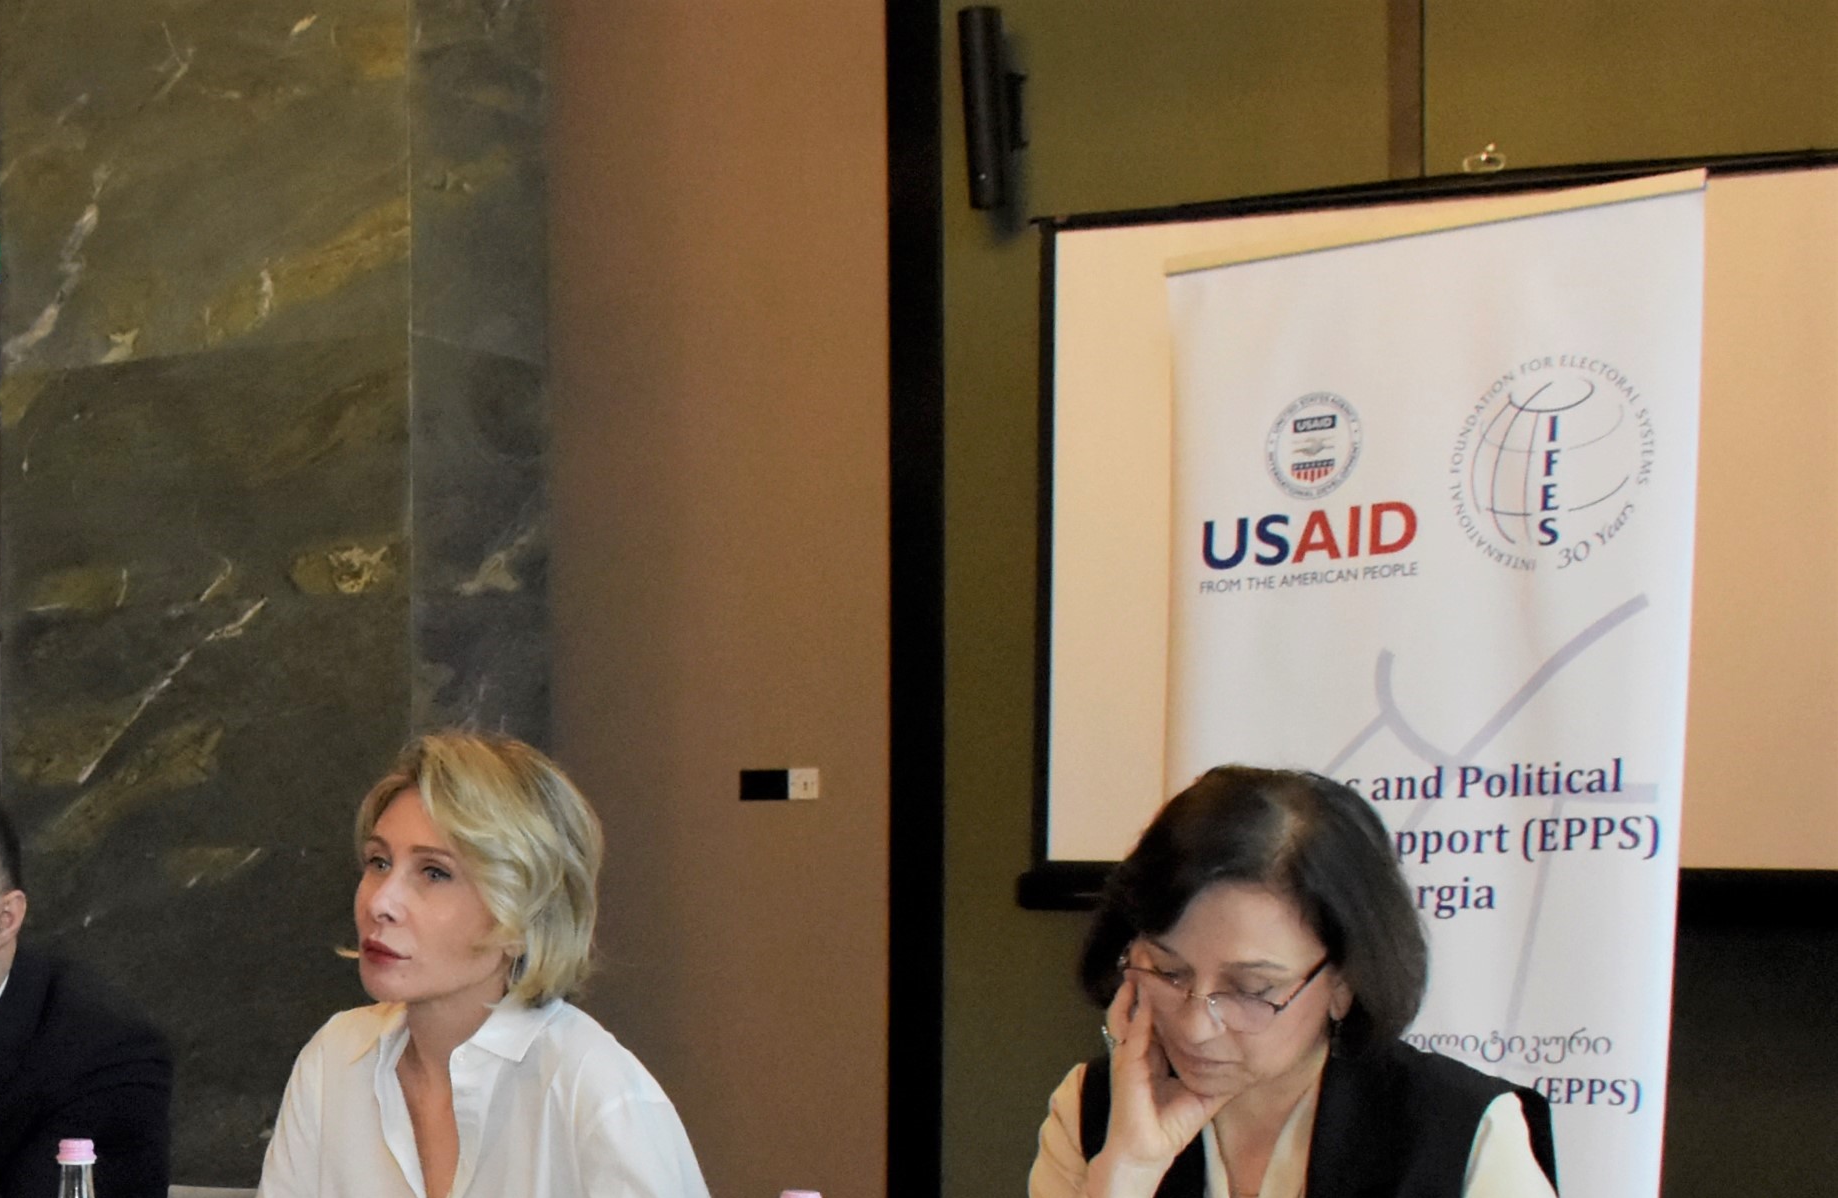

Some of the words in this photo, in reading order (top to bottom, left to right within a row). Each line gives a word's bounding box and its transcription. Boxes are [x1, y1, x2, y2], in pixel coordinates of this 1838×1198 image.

[1520, 356, 1555, 375] FOR
[1560, 355, 1640, 405] ELECTORAL
[1450, 371, 1515, 474] FOUNDATION
[1635, 408, 1655, 486] SYSTEMS
[1538, 415, 1561, 547] IFES
[1202, 501, 1418, 570] USAID
[1449, 484, 1536, 572] INTERNATIONAL
[1557, 540, 1592, 569] 30
[1595, 501, 1636, 546] Years
[1199, 577, 1242, 595] FROM
[1246, 575, 1276, 591] THE
[1279, 567, 1359, 588] AMERICAN
[1362, 562, 1419, 582] PEOPLE
[1371, 765, 1443, 801] and
[1457, 758, 1623, 799] Political
[1396, 826, 1510, 865] pport
[1522, 815, 1661, 862] (EPPS)
[1416, 877, 1496, 919] rgia
[1403, 1027, 1613, 1064] ოლიტიკური
[1531, 1076, 1643, 1115] (EPPS)
